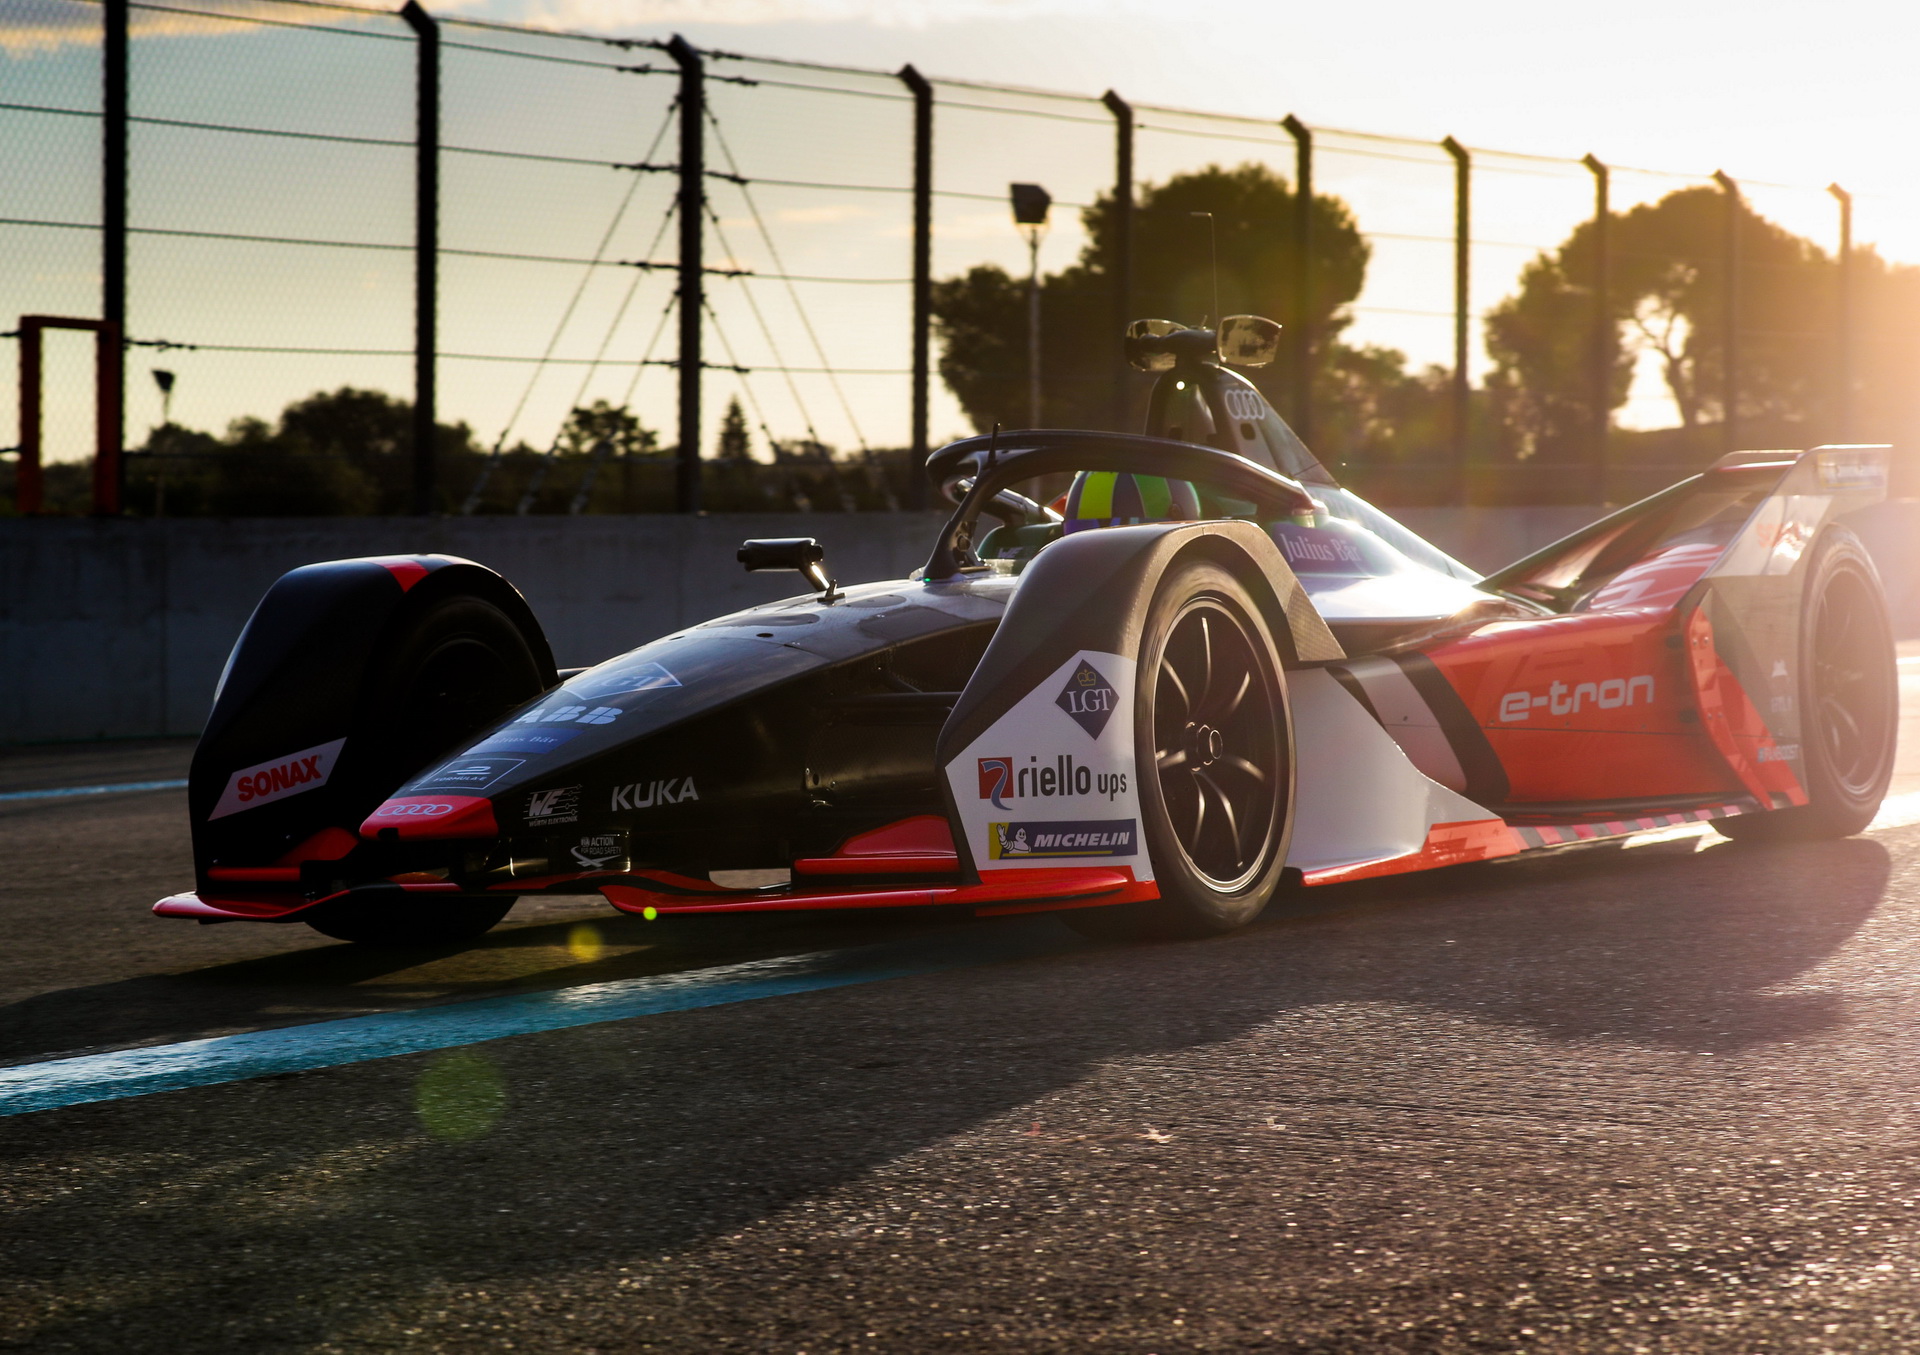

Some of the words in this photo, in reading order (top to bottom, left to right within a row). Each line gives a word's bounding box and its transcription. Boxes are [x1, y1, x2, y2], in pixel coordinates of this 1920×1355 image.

[1279, 533, 1336, 563] Julius
[1329, 538, 1363, 562] Bär
[1066, 688, 1113, 714] LGT
[1499, 675, 1655, 723] e-tron
[513, 705, 623, 725] ABB
[236, 754, 323, 803] SONAX
[1017, 754, 1092, 798] riello
[1097, 772, 1128, 802] ups
[611, 775, 700, 812] KUKA
[589, 846, 604, 855] ROAD
[604, 845, 622, 855] SAFETY
[590, 836, 615, 847] ACTION
[1033, 831, 1130, 848] MICHELIN
